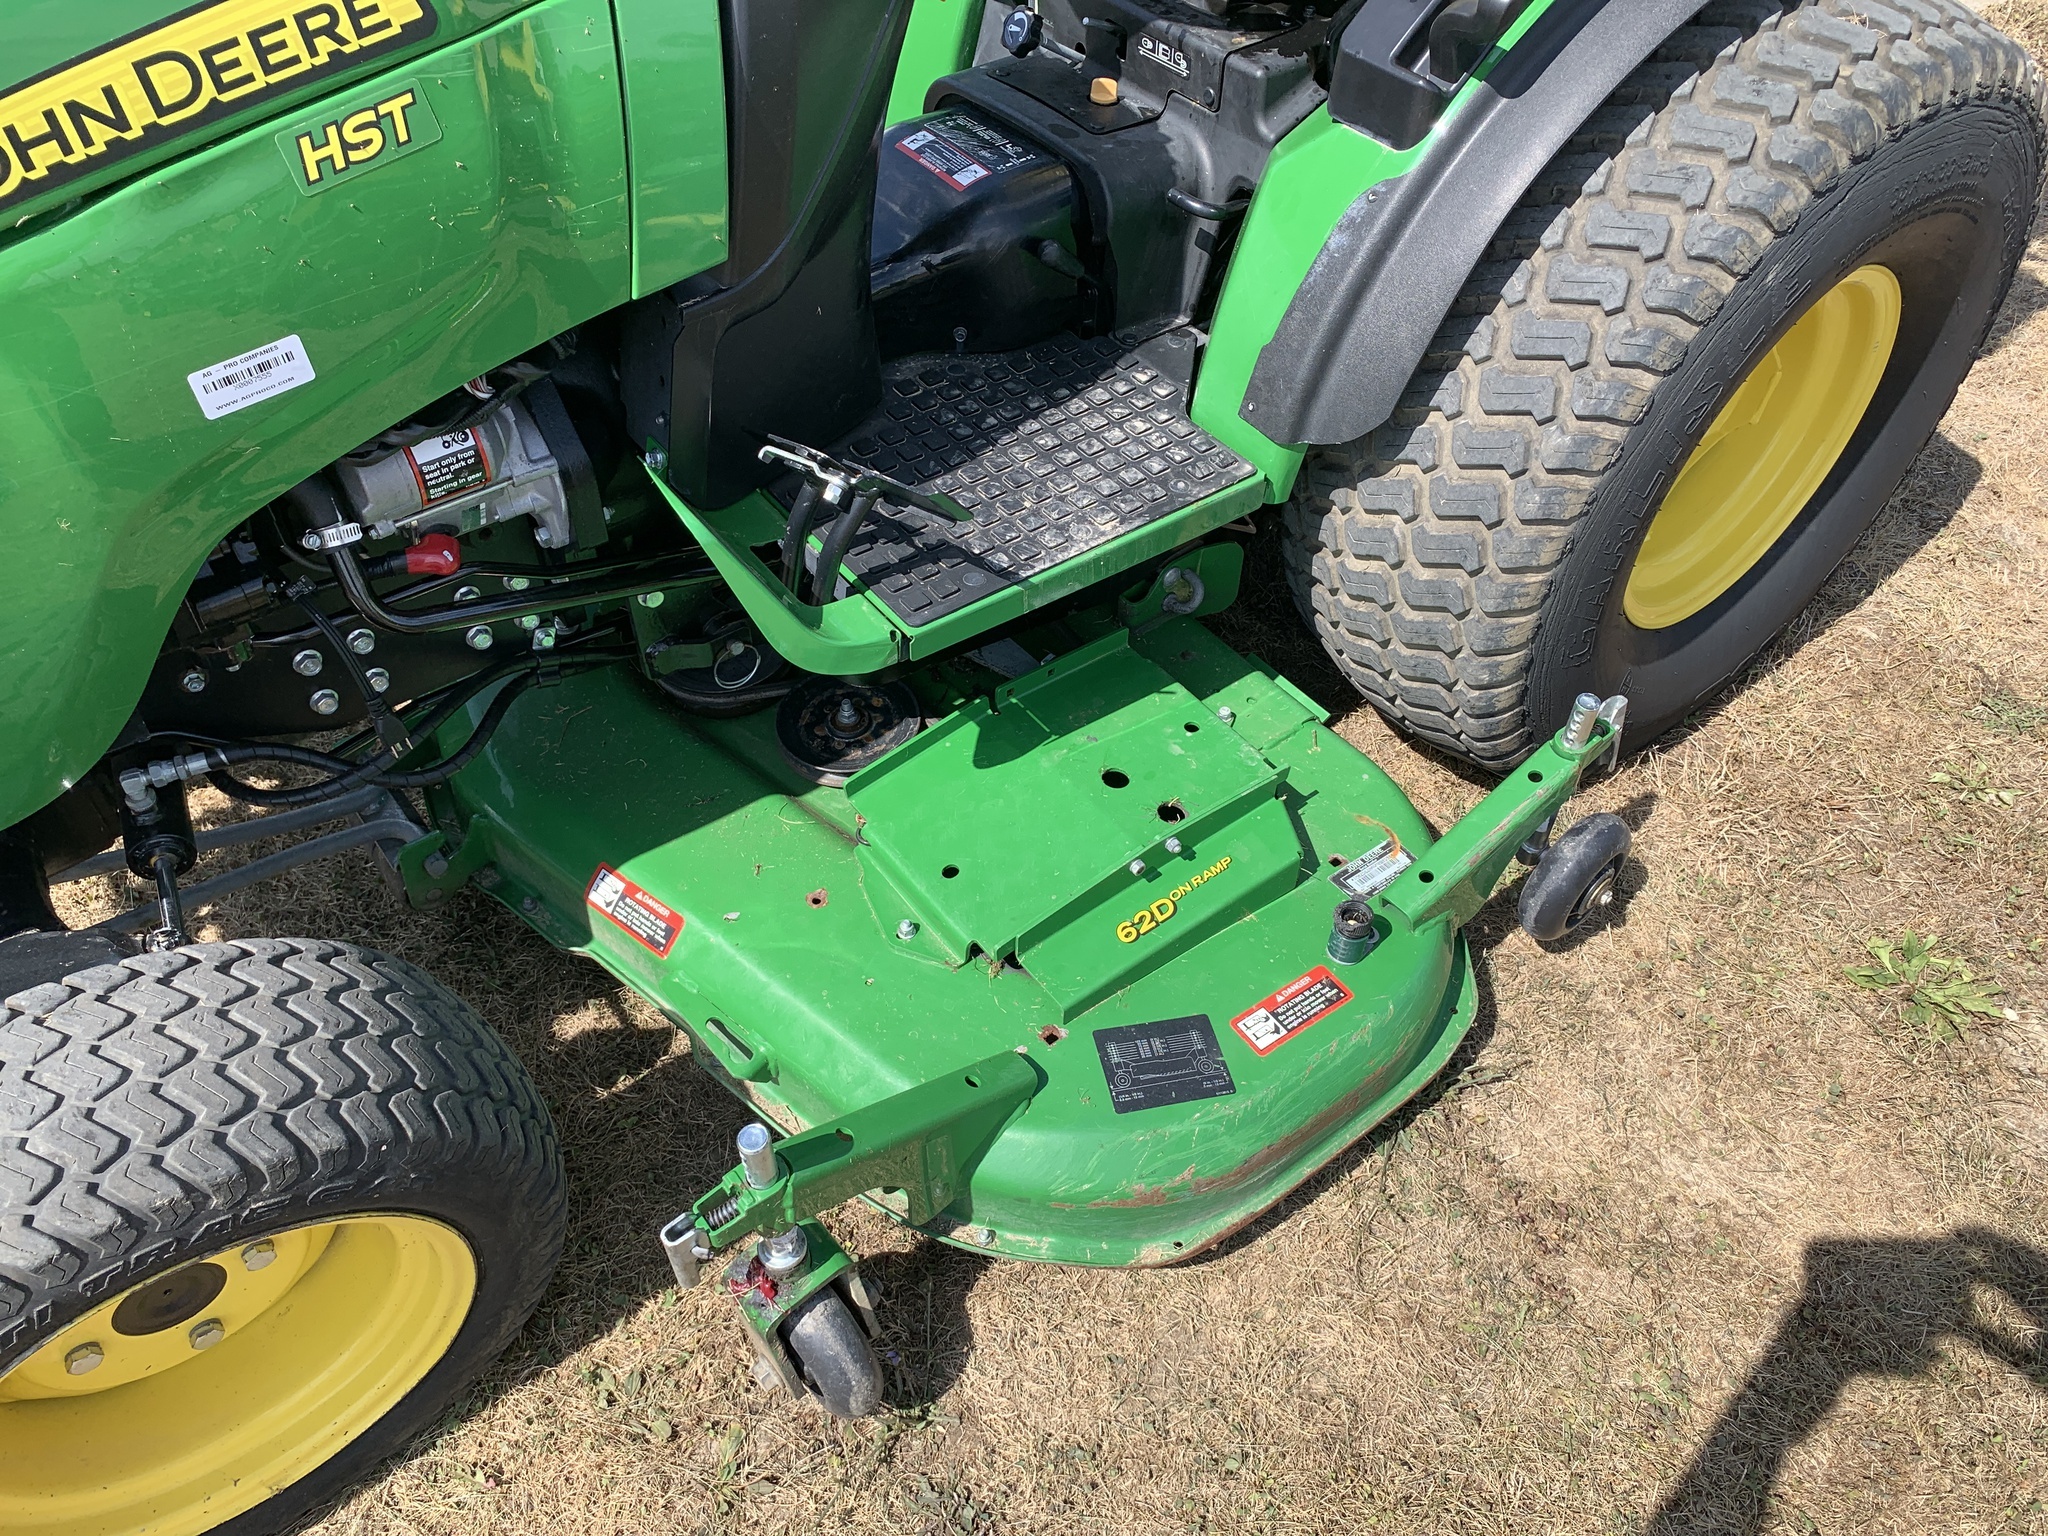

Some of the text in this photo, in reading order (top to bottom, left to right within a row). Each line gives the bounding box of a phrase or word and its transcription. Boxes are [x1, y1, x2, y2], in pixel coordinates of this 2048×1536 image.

[0, 0, 393, 187] HN DEERE
[295, 87, 417, 186] HST
[202, 370, 212, 378] AG
[223, 361, 238, 370] PRO
[240, 345, 278, 363] COMPANIES
[216, 377, 294, 410] WWW.AGPROCO.COM
[422, 450, 474, 472] Start only from
[425, 470, 440, 479] seat
[450, 460, 466, 472] park
[427, 473, 454, 486] neutral.
[429, 481, 457, 494] Starting
[467, 472, 482, 481] gear
[1347, 858, 1364, 873] JOHN
[1363, 848, 1384, 863] DEERE
[643, 895, 670, 917] DANGER
[1116, 855, 1233, 944] 62D ON RAMP
[625, 897, 666, 929] ROTATING BLADE
[1277, 983, 1322, 1013] ROTATING BLADE
[1281, 976, 1312, 996] DANGER
[1293, 1004, 1302, 1012] put
[1301, 996, 1316, 1006] hands
